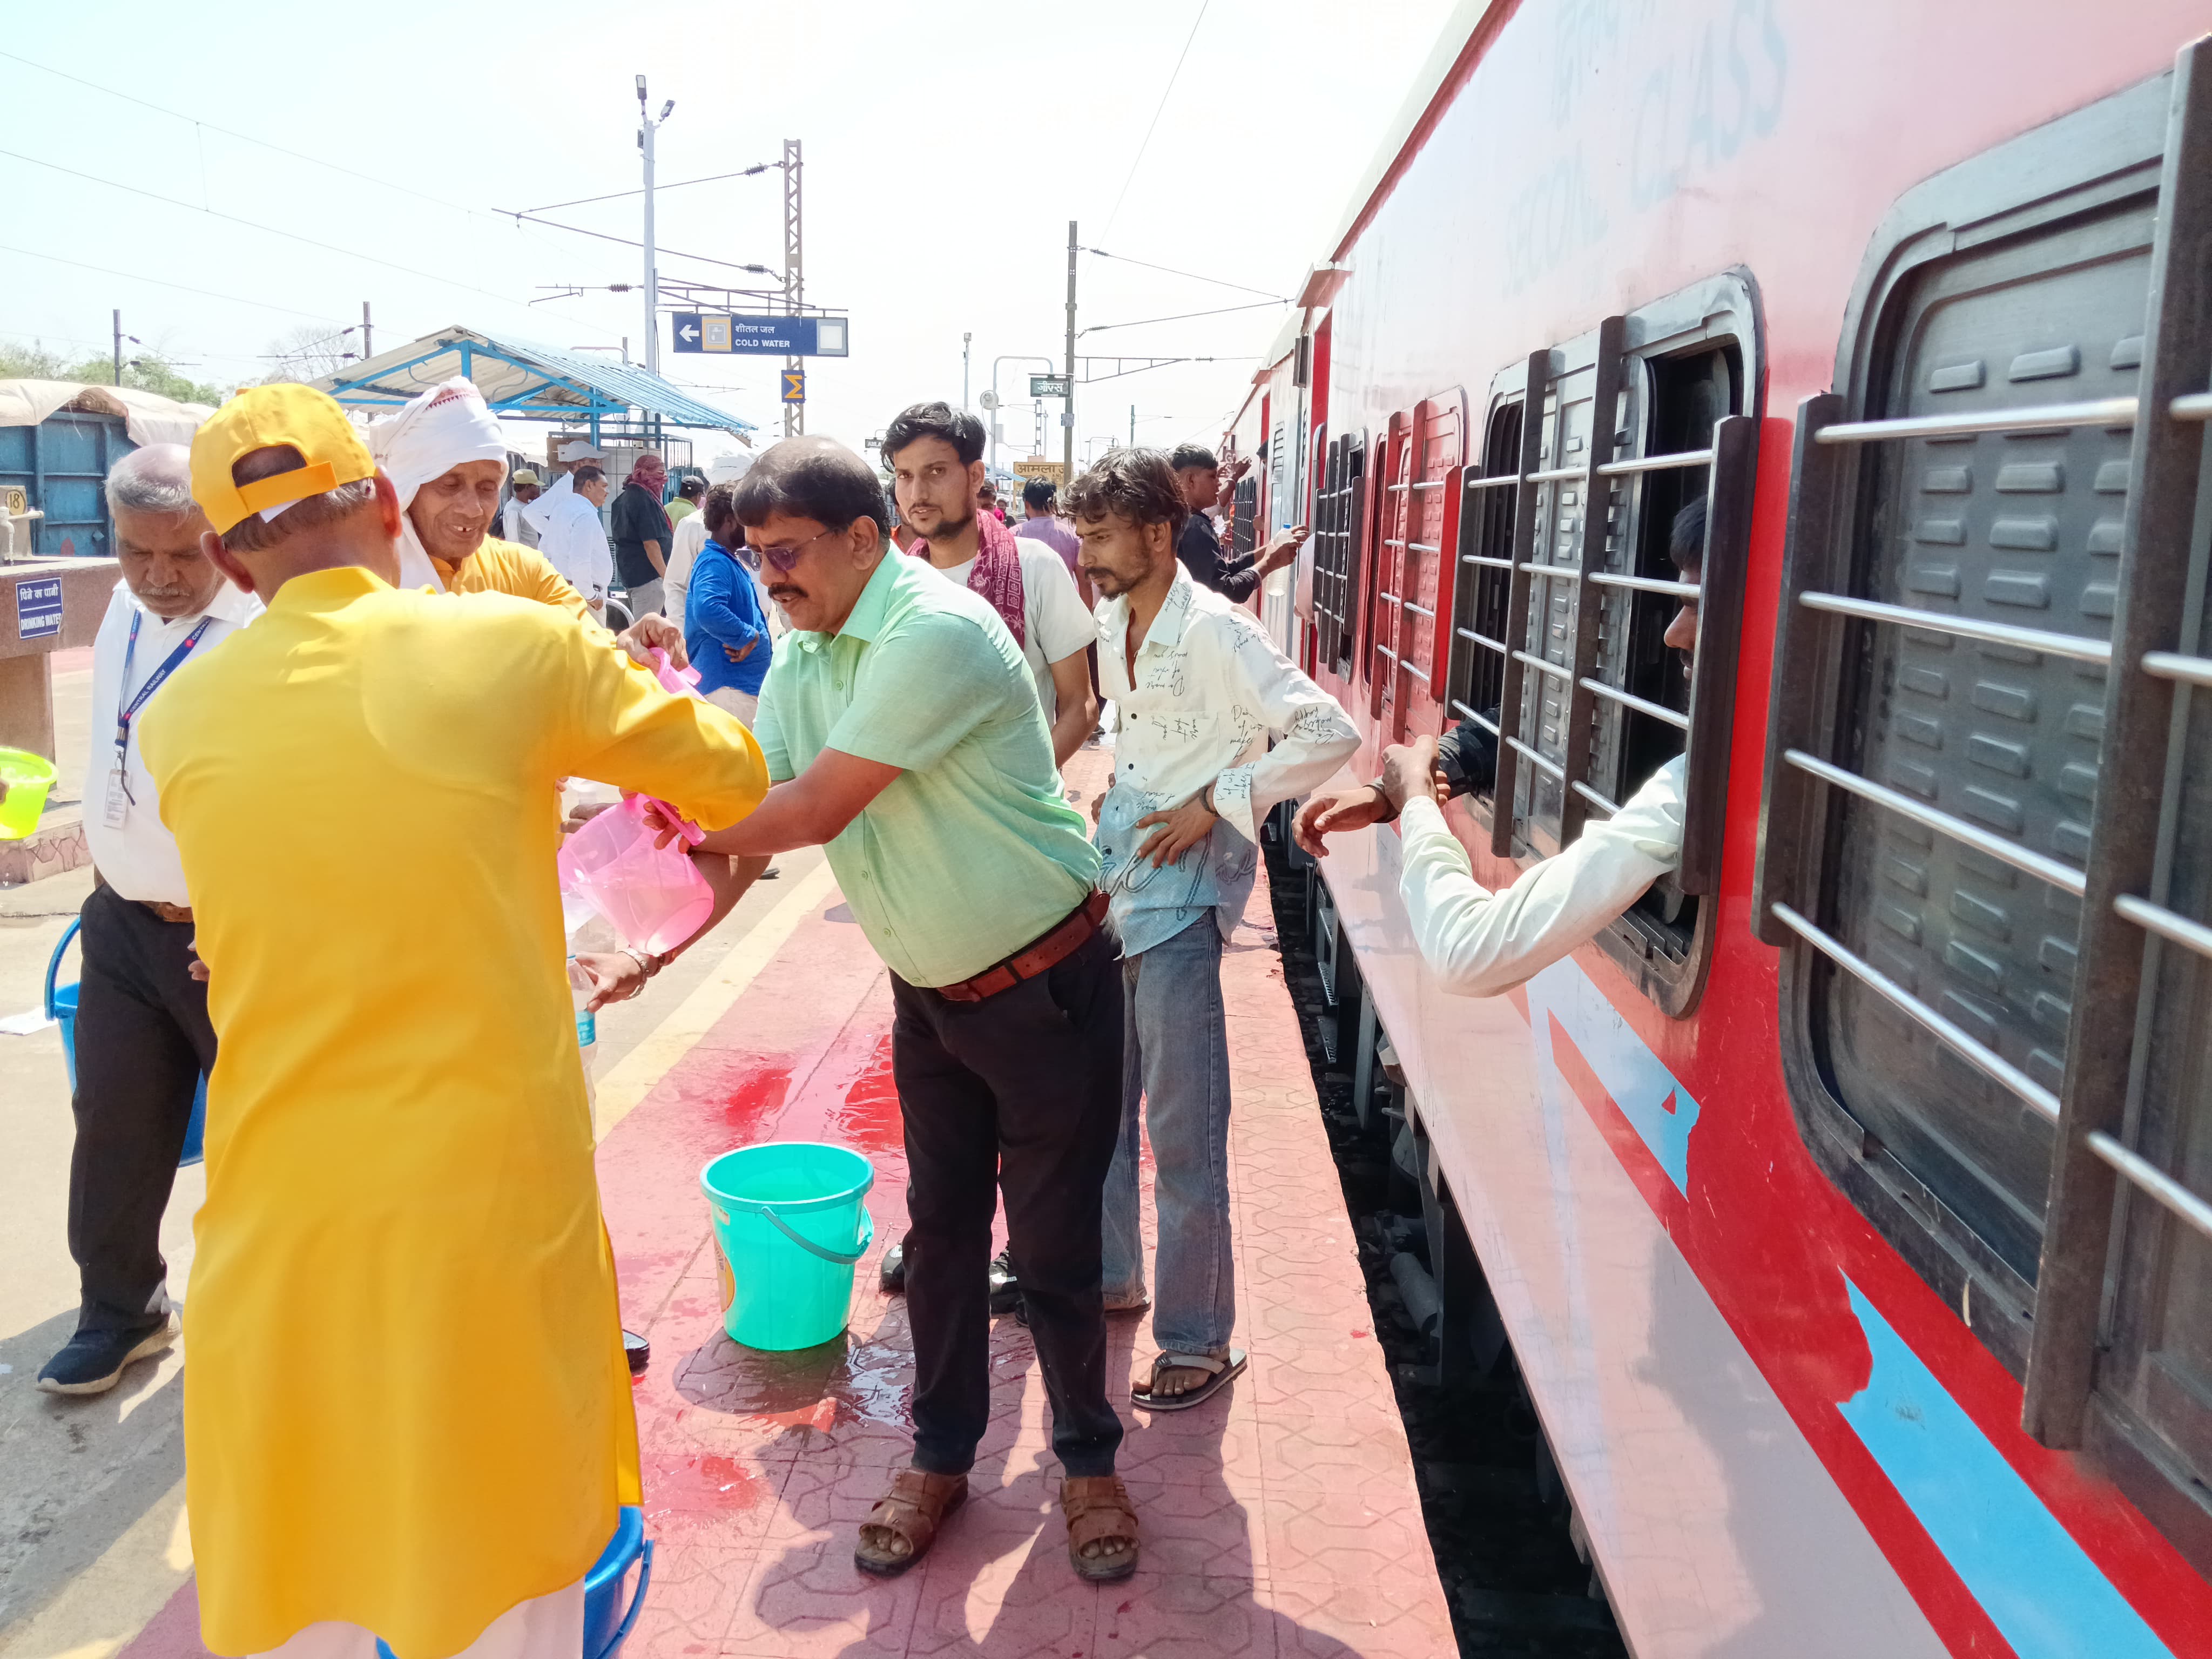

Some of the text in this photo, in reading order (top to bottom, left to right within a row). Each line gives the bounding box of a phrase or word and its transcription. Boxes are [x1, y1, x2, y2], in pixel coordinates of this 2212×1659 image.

[735, 323, 758, 333] शीतल
[735, 339, 790, 348] COLD WATER
[1017, 464, 1056, 474] आमला
[9, 493, 20, 509] 18
[44, 583, 59, 597] पानी
[21, 615, 45, 631] DRINKING
[130, 669, 166, 713] CENTRAL RAILWAY
